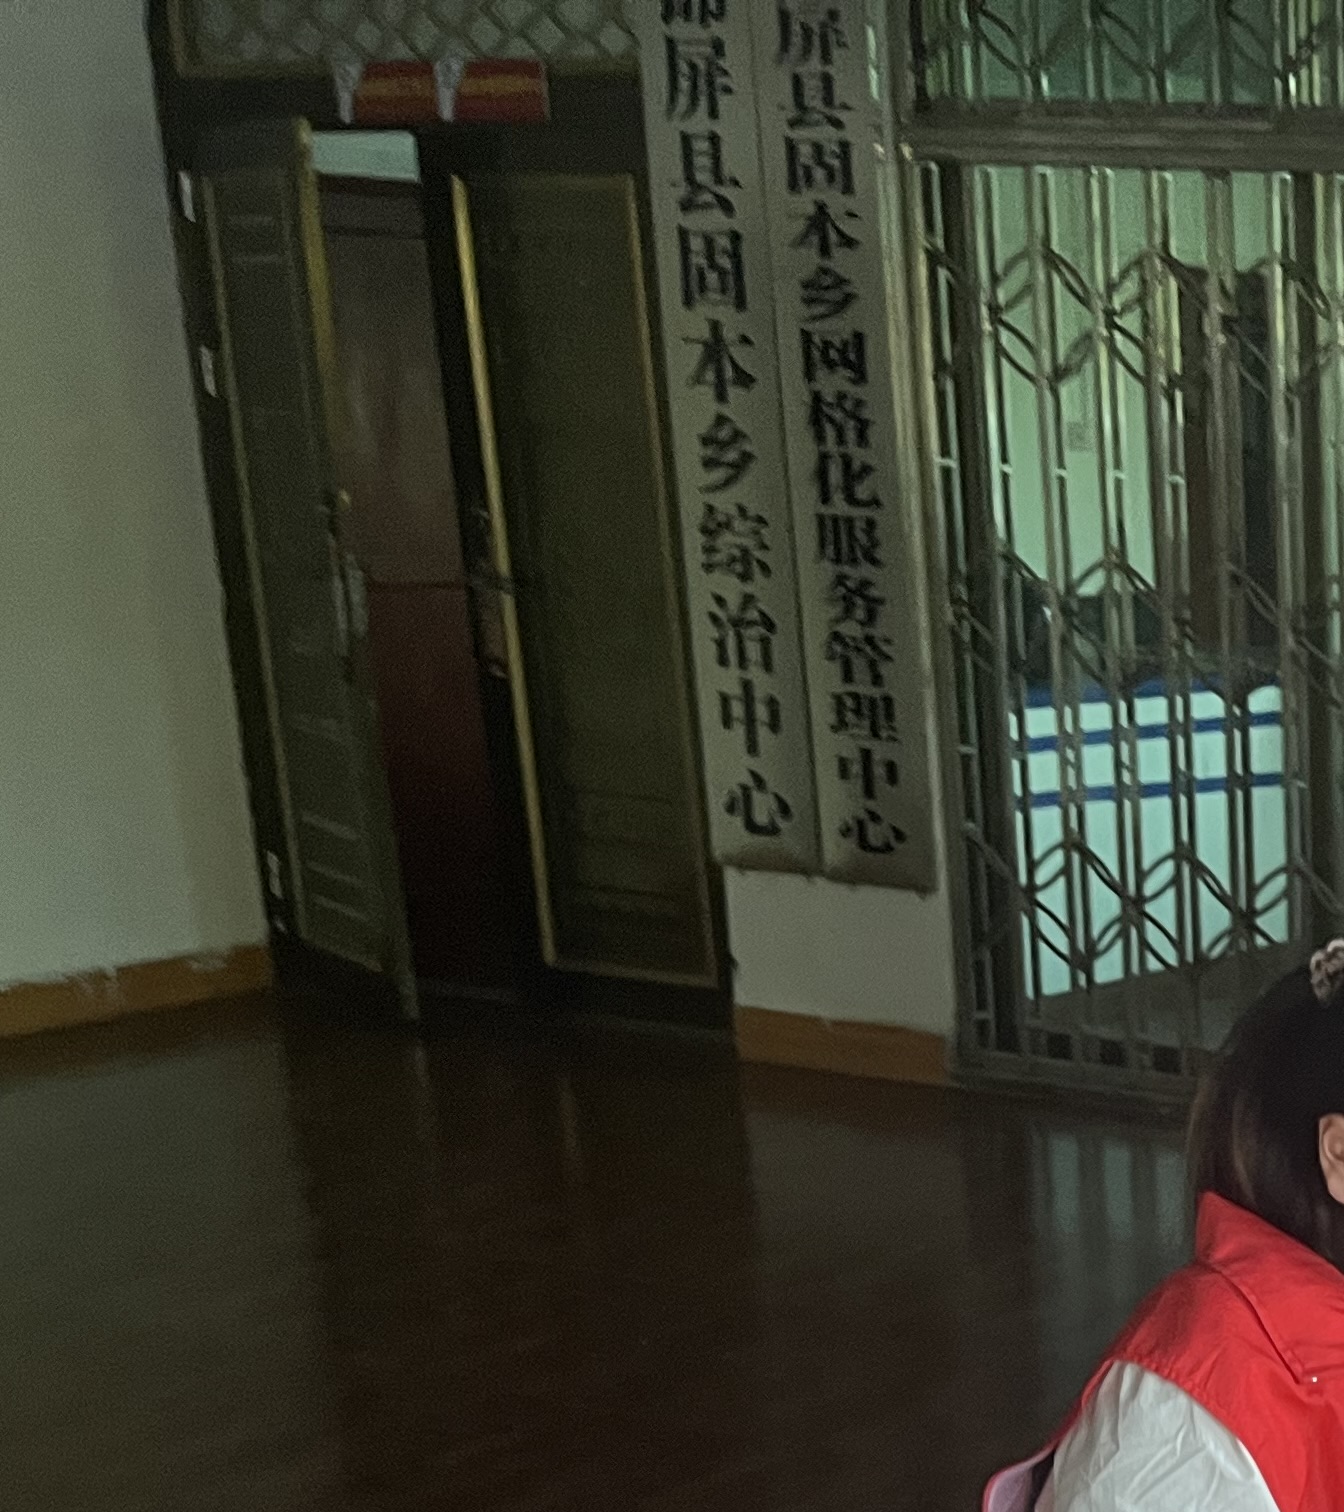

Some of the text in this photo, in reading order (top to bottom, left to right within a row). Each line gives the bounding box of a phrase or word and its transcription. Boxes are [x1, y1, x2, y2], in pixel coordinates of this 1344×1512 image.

[661, 0, 793, 837] 屏县固本乡综治中心
